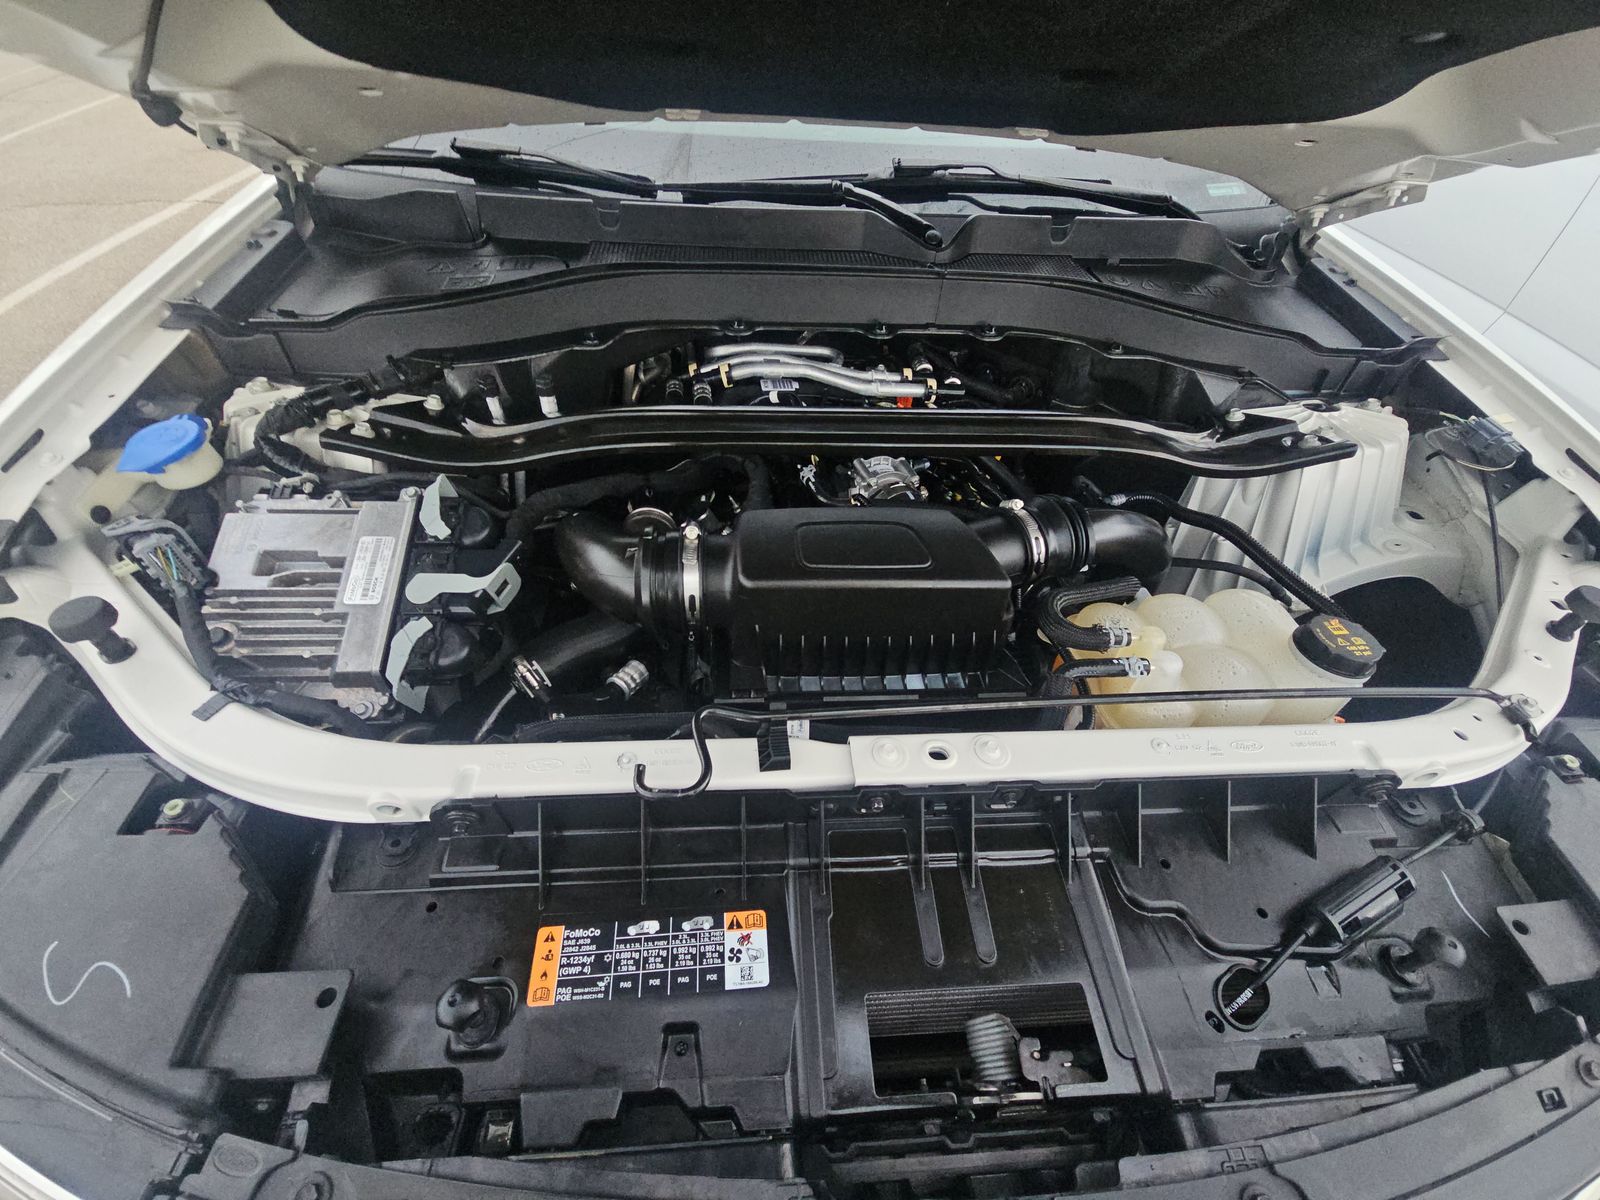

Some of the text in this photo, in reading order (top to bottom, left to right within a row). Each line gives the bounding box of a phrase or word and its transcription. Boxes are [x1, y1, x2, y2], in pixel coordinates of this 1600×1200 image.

[564, 927, 601, 938] FoMoCo
[689, 945, 697, 954] kg
[716, 943, 724, 952] kg
[632, 951, 640, 959] kg
[659, 949, 668, 957] kg
[560, 954, 595, 966] R-1234yf
[559, 965, 591, 977] (GWP 4)
[677, 976, 690, 984] PAG
[556, 986, 572, 995] PAG
[555, 993, 572, 1002] POE
